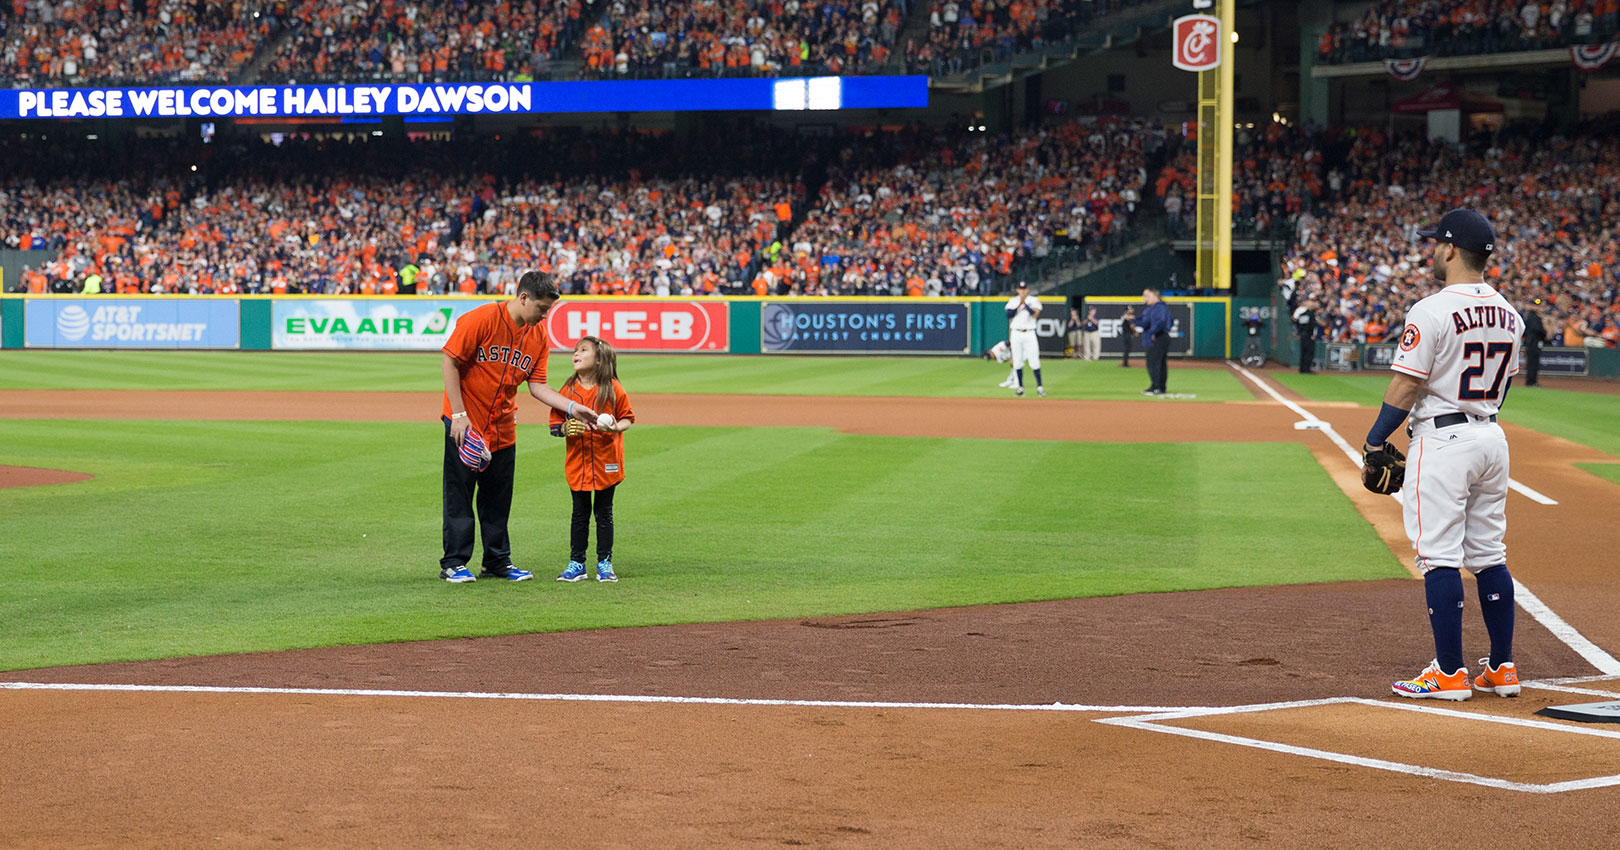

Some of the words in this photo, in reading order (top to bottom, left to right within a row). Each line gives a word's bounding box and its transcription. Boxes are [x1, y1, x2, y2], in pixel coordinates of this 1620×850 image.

[18, 91, 123, 117] PLEASE
[127, 88, 278, 116] WELCOME
[283, 87, 392, 114] HAILEY
[397, 85, 532, 113] DAWSON
[92, 305, 142, 324] AT&T
[780, 313, 897, 330] HOUSTON'S
[905, 313, 959, 330] FIRST
[1452, 305, 1517, 336] ALTUVE
[91, 323, 207, 341] SPORTSNET
[286, 318, 350, 334] EVA
[356, 318, 414, 334] AIR
[567, 311, 694, 340] H-E-B
[781, 331, 850, 342] BAPTIST
[859, 331, 924, 342] CHURCH
[1457, 341, 1514, 401] 27
